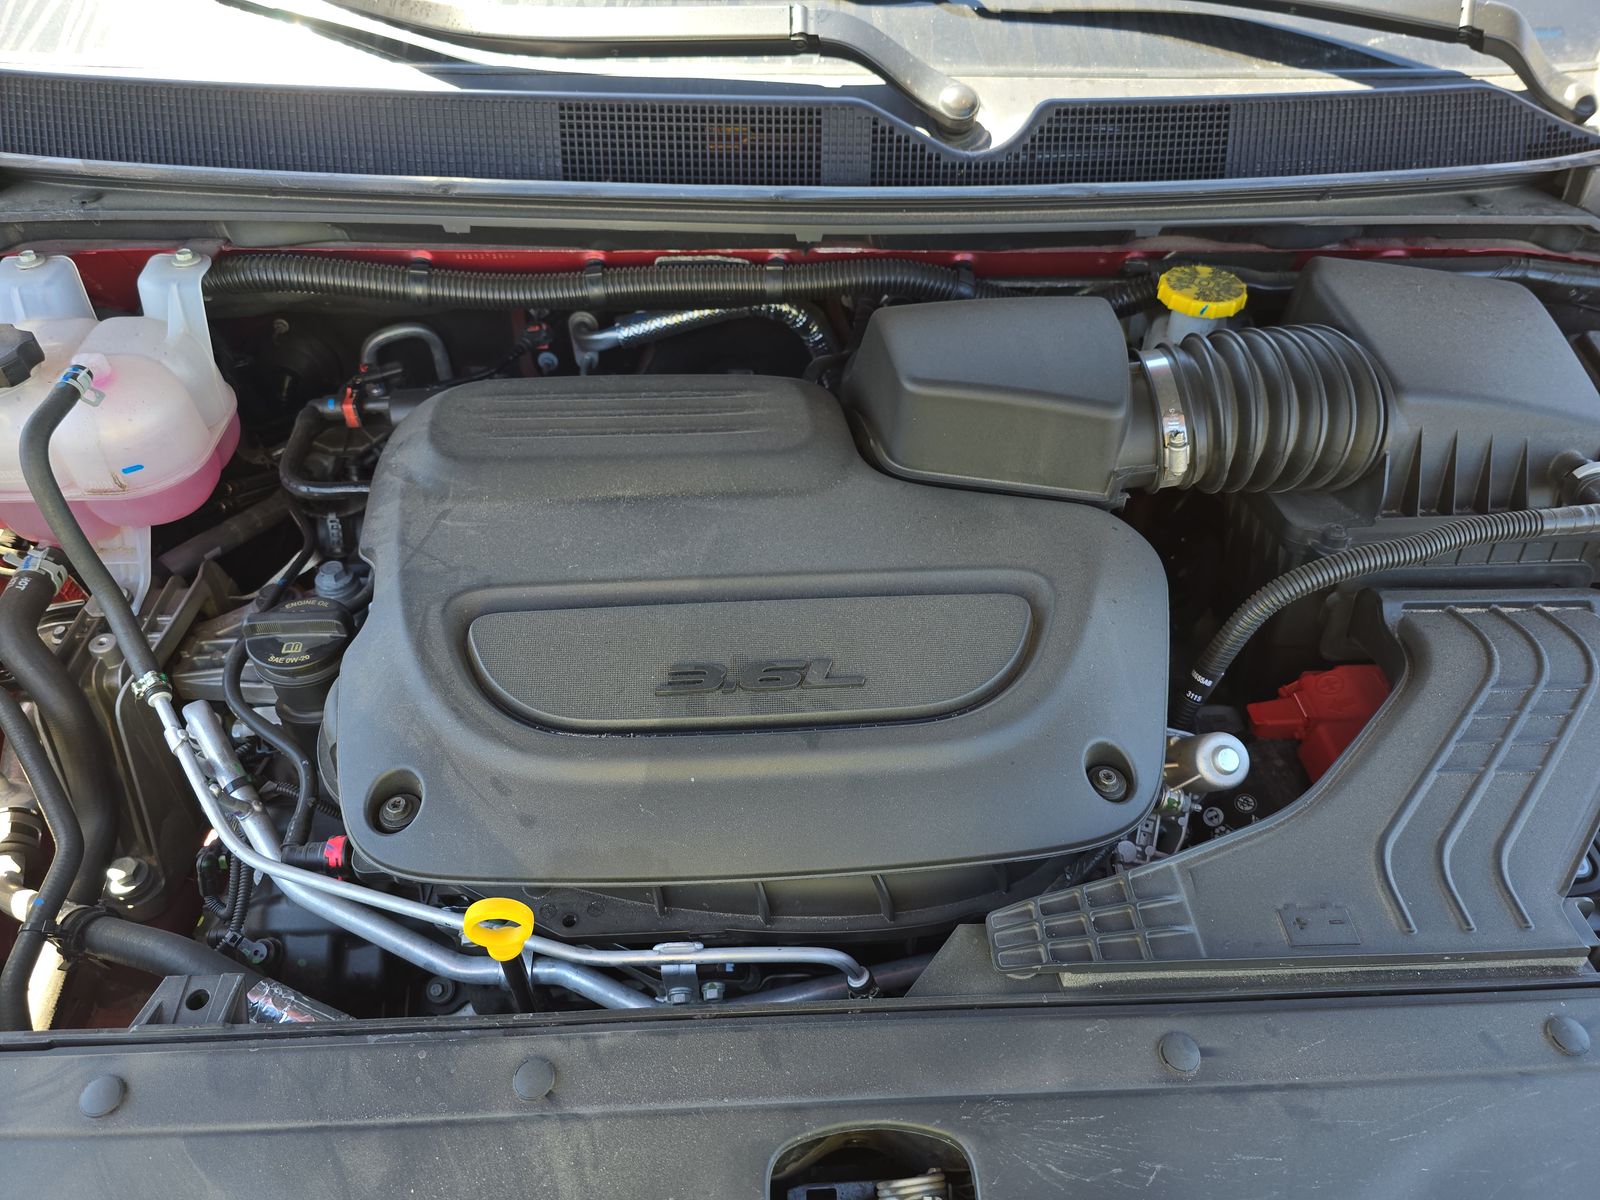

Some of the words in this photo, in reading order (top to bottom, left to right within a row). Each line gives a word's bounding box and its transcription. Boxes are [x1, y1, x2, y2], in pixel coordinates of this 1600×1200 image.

[284, 600, 316, 609] ENGINE
[317, 600, 329, 608] OIL
[267, 655, 285, 664] SAE
[285, 654, 311, 664] 0W-20
[655, 657, 866, 697] 3.6L
